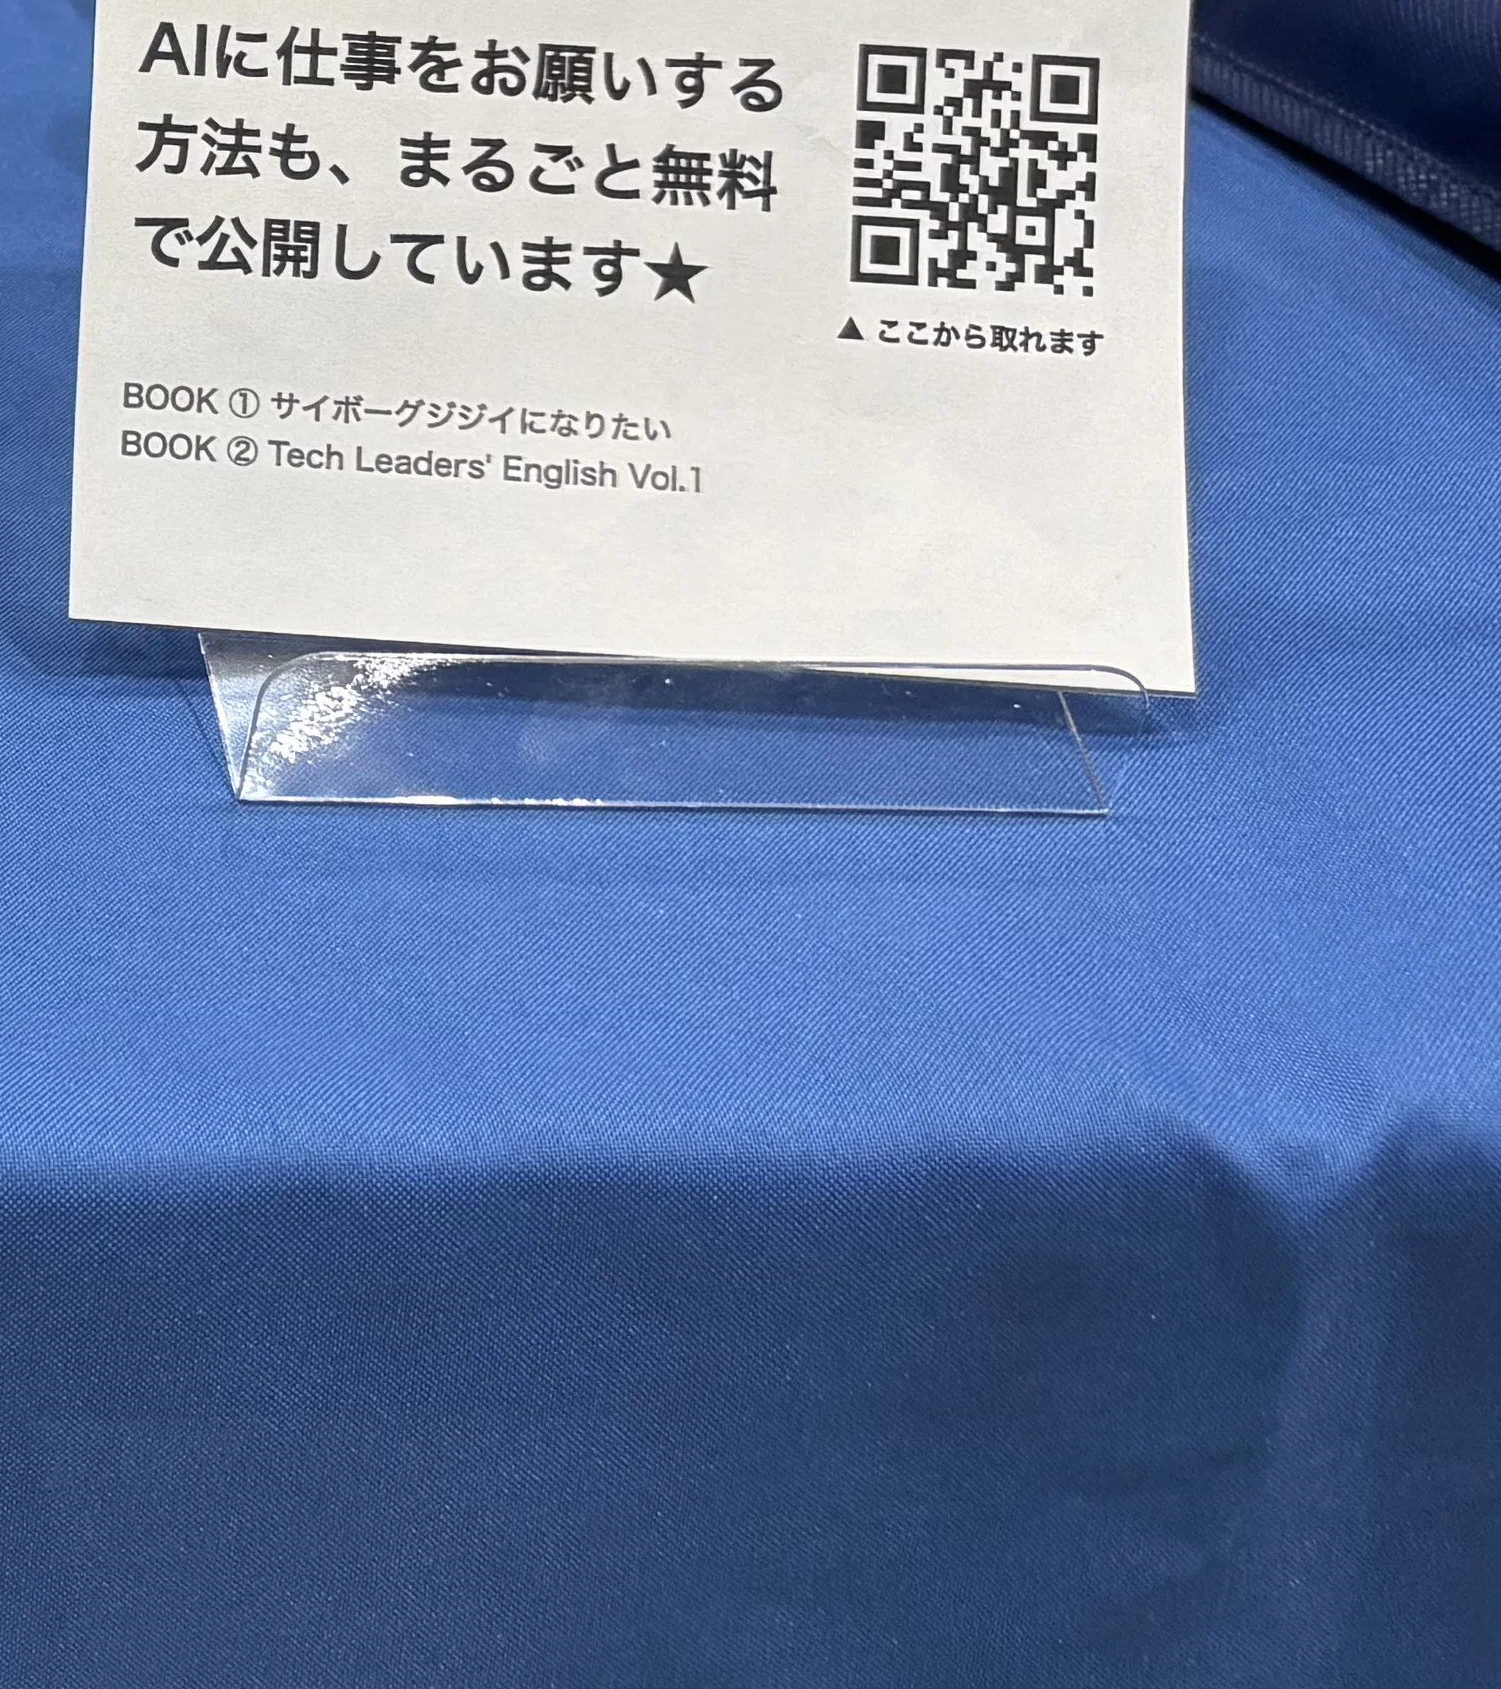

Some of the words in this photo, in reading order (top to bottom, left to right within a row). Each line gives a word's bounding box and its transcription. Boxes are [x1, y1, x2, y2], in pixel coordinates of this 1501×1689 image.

[138, 22, 782, 112] AIに仕事をお願いする
[136, 114, 777, 212] 方法も、まるごと無料
[879, 320, 1104, 356] ここから取れます
[123, 382, 218, 414] BOOK
[271, 392, 671, 440] サイボーグジジイになりたい
[122, 430, 216, 462] BOOK
[268, 440, 343, 470] Tech
[356, 446, 491, 479] Leaders'
[504, 455, 616, 489] English
[628, 463, 700, 493] Vol.1
